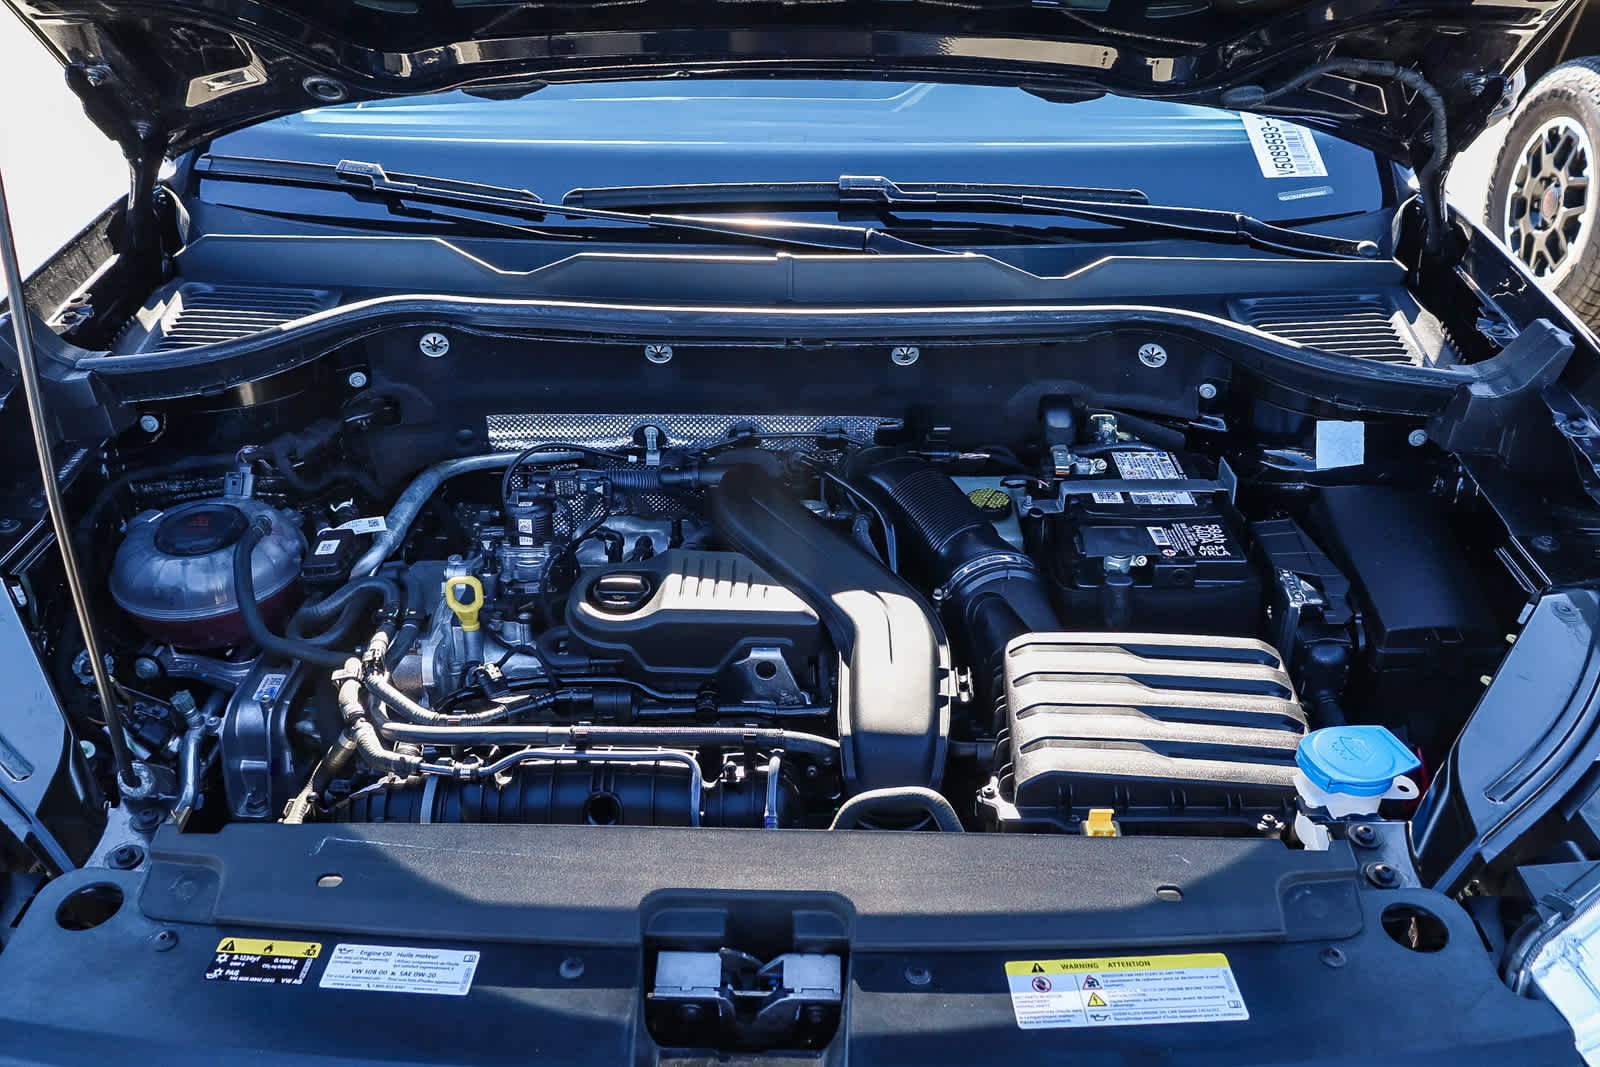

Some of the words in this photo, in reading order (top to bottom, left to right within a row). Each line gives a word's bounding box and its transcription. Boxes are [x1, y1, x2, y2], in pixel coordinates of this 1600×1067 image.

[1257, 117, 1296, 176] V5089593-
[1060, 962, 1099, 970] WARNING
[1107, 960, 1151, 968] ATTENTION
